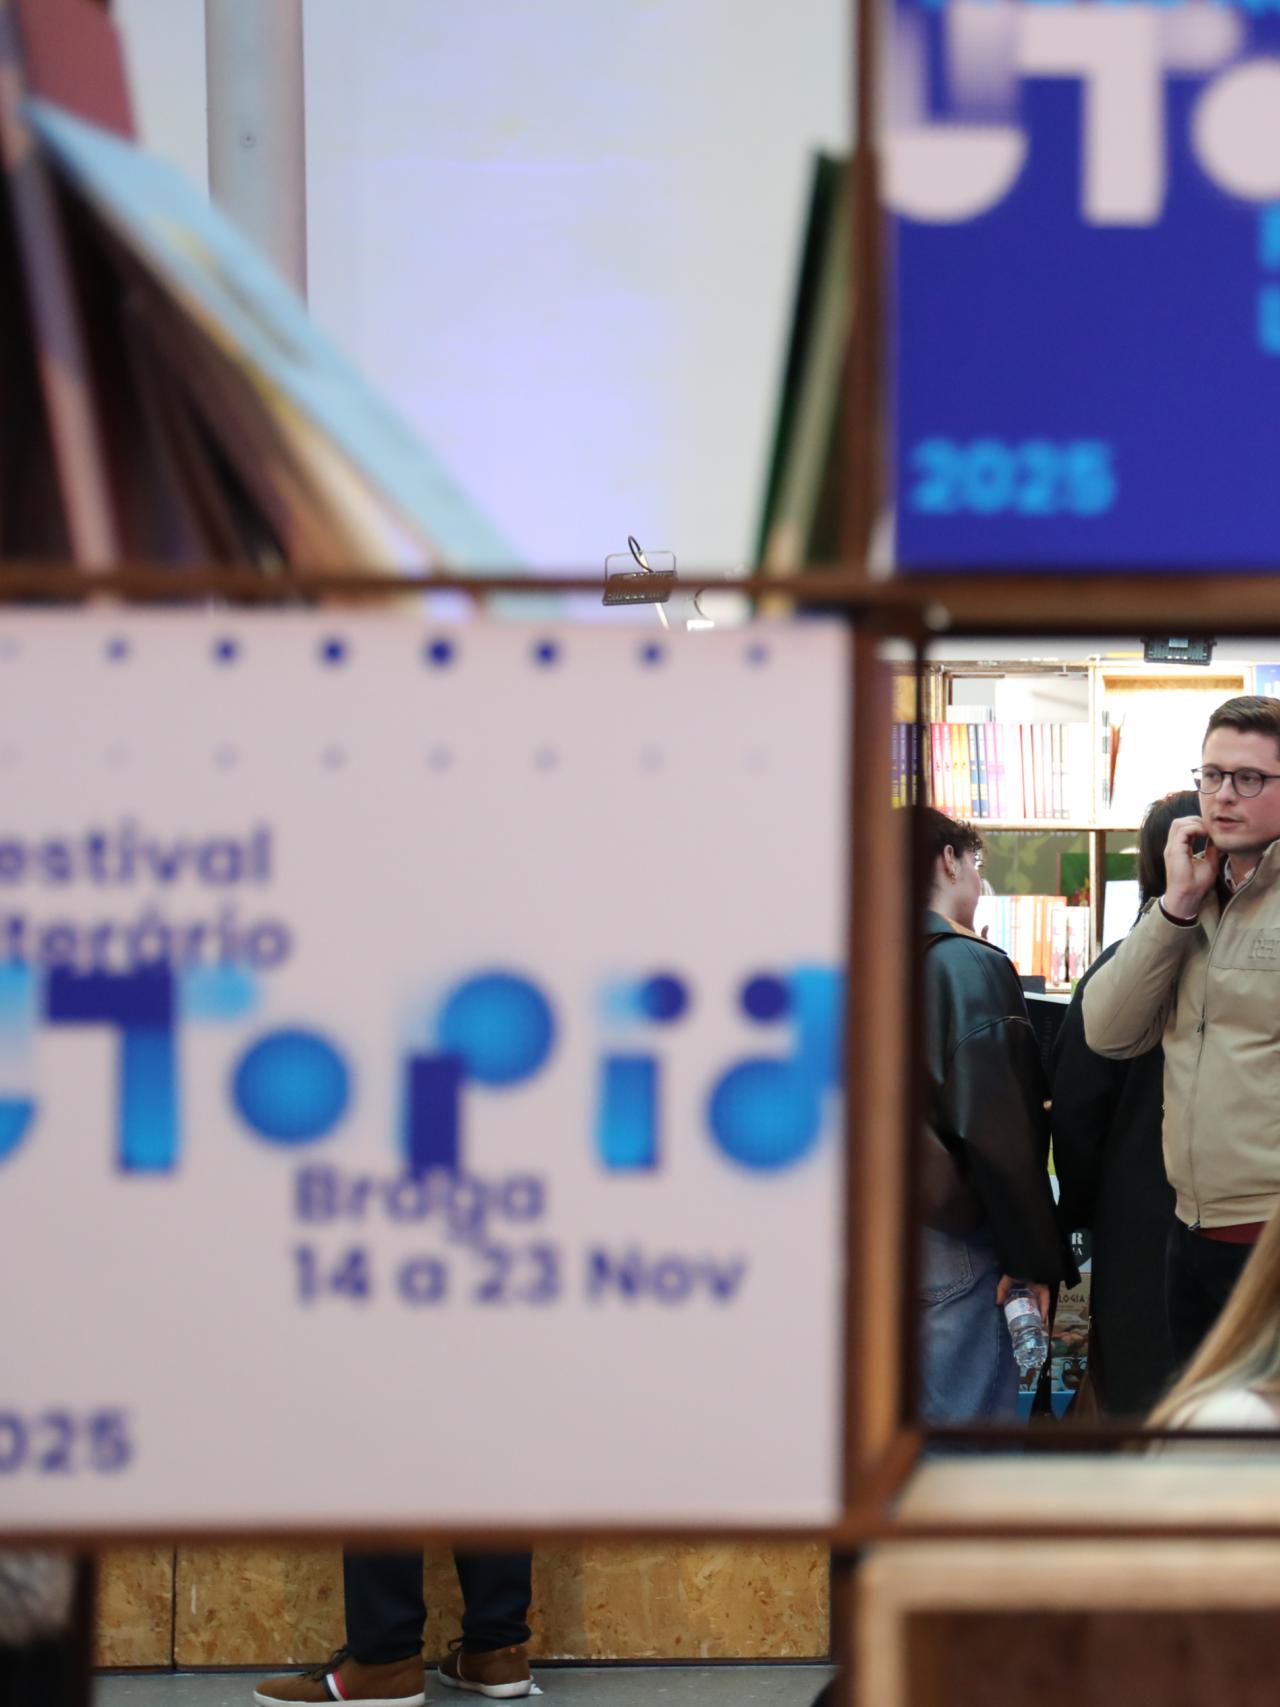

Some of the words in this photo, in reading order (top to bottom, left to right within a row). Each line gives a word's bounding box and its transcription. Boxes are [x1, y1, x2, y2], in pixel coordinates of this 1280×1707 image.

[910, 440, 1116, 516] 2025
[294, 1163, 547, 1245] Braga
[294, 1243, 372, 1305] 14
[395, 1256, 449, 1305] a
[472, 1243, 561, 1305] 23
[585, 1244, 746, 1304] Nov
